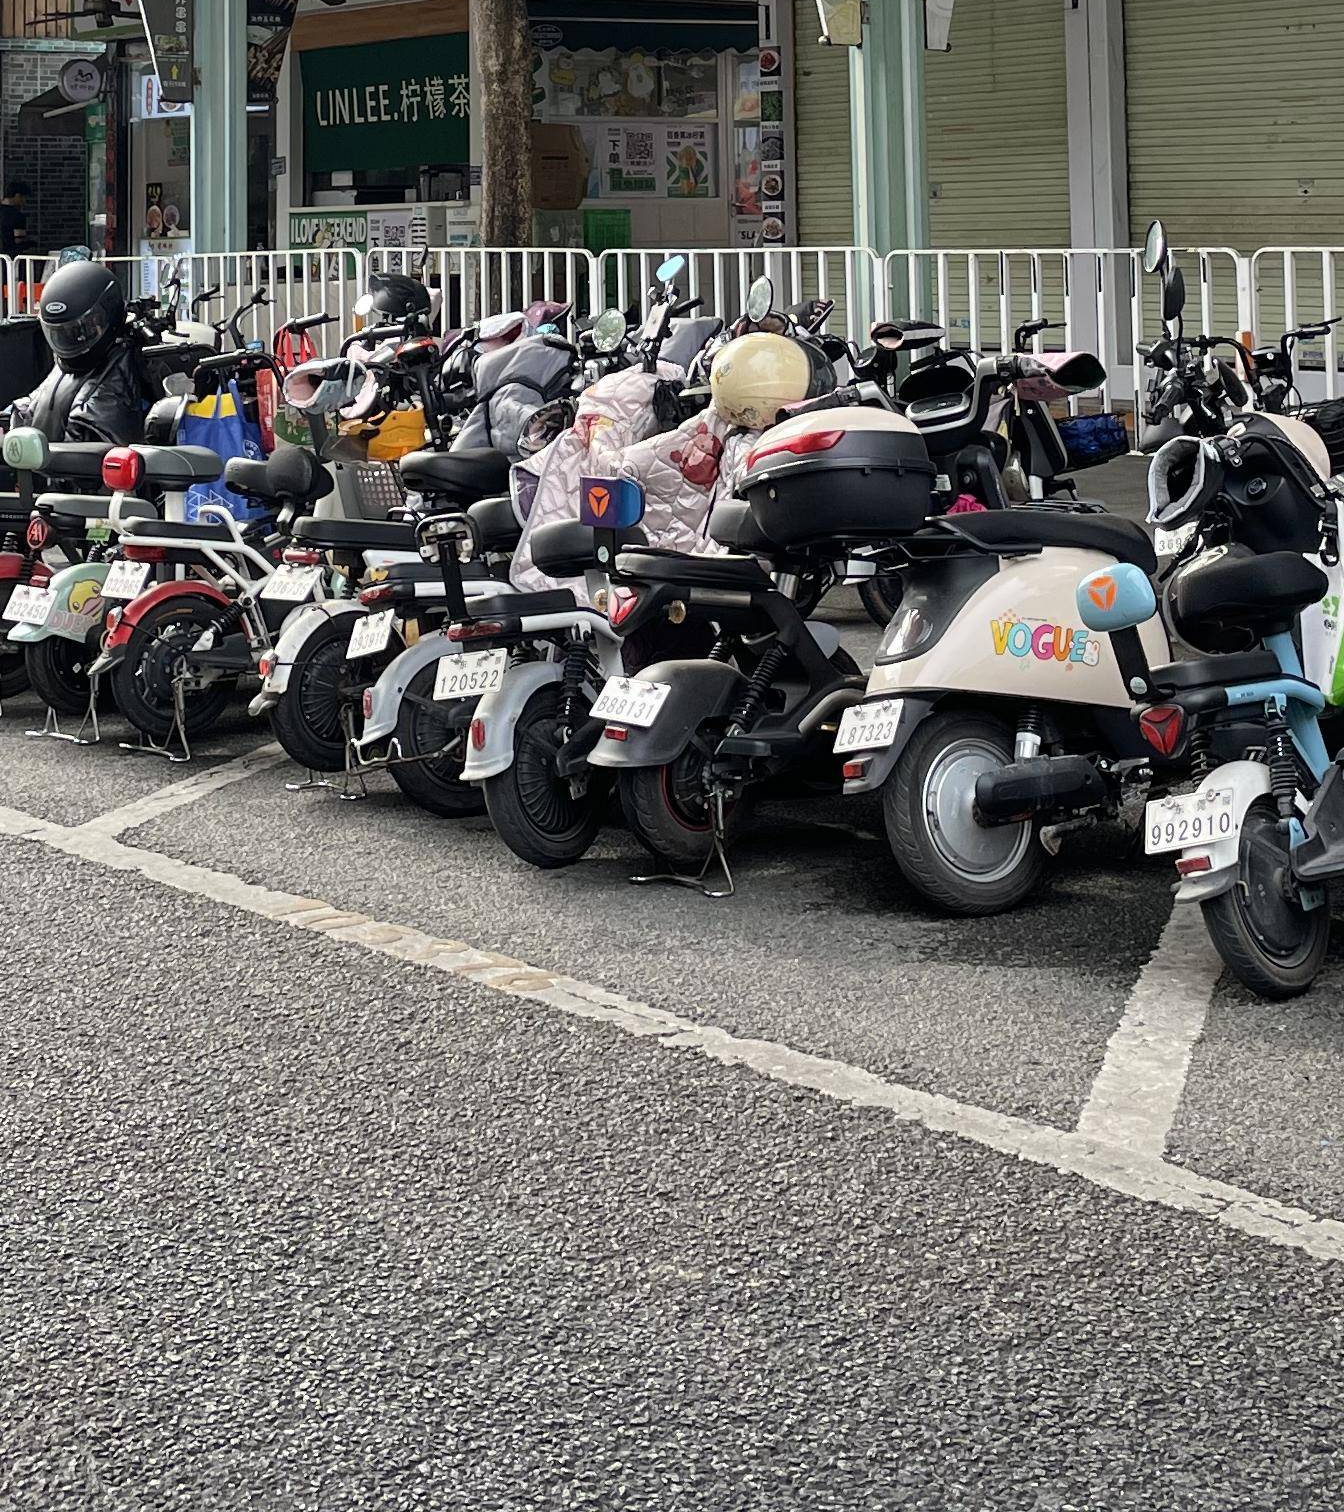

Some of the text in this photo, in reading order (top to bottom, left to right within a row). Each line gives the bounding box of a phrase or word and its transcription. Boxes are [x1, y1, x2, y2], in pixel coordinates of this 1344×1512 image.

[990, 619, 1090, 663] VOGUE
[441, 669, 499, 694] 120522
[839, 721, 894, 747] L87323
[1151, 812, 1231, 846] 992910
